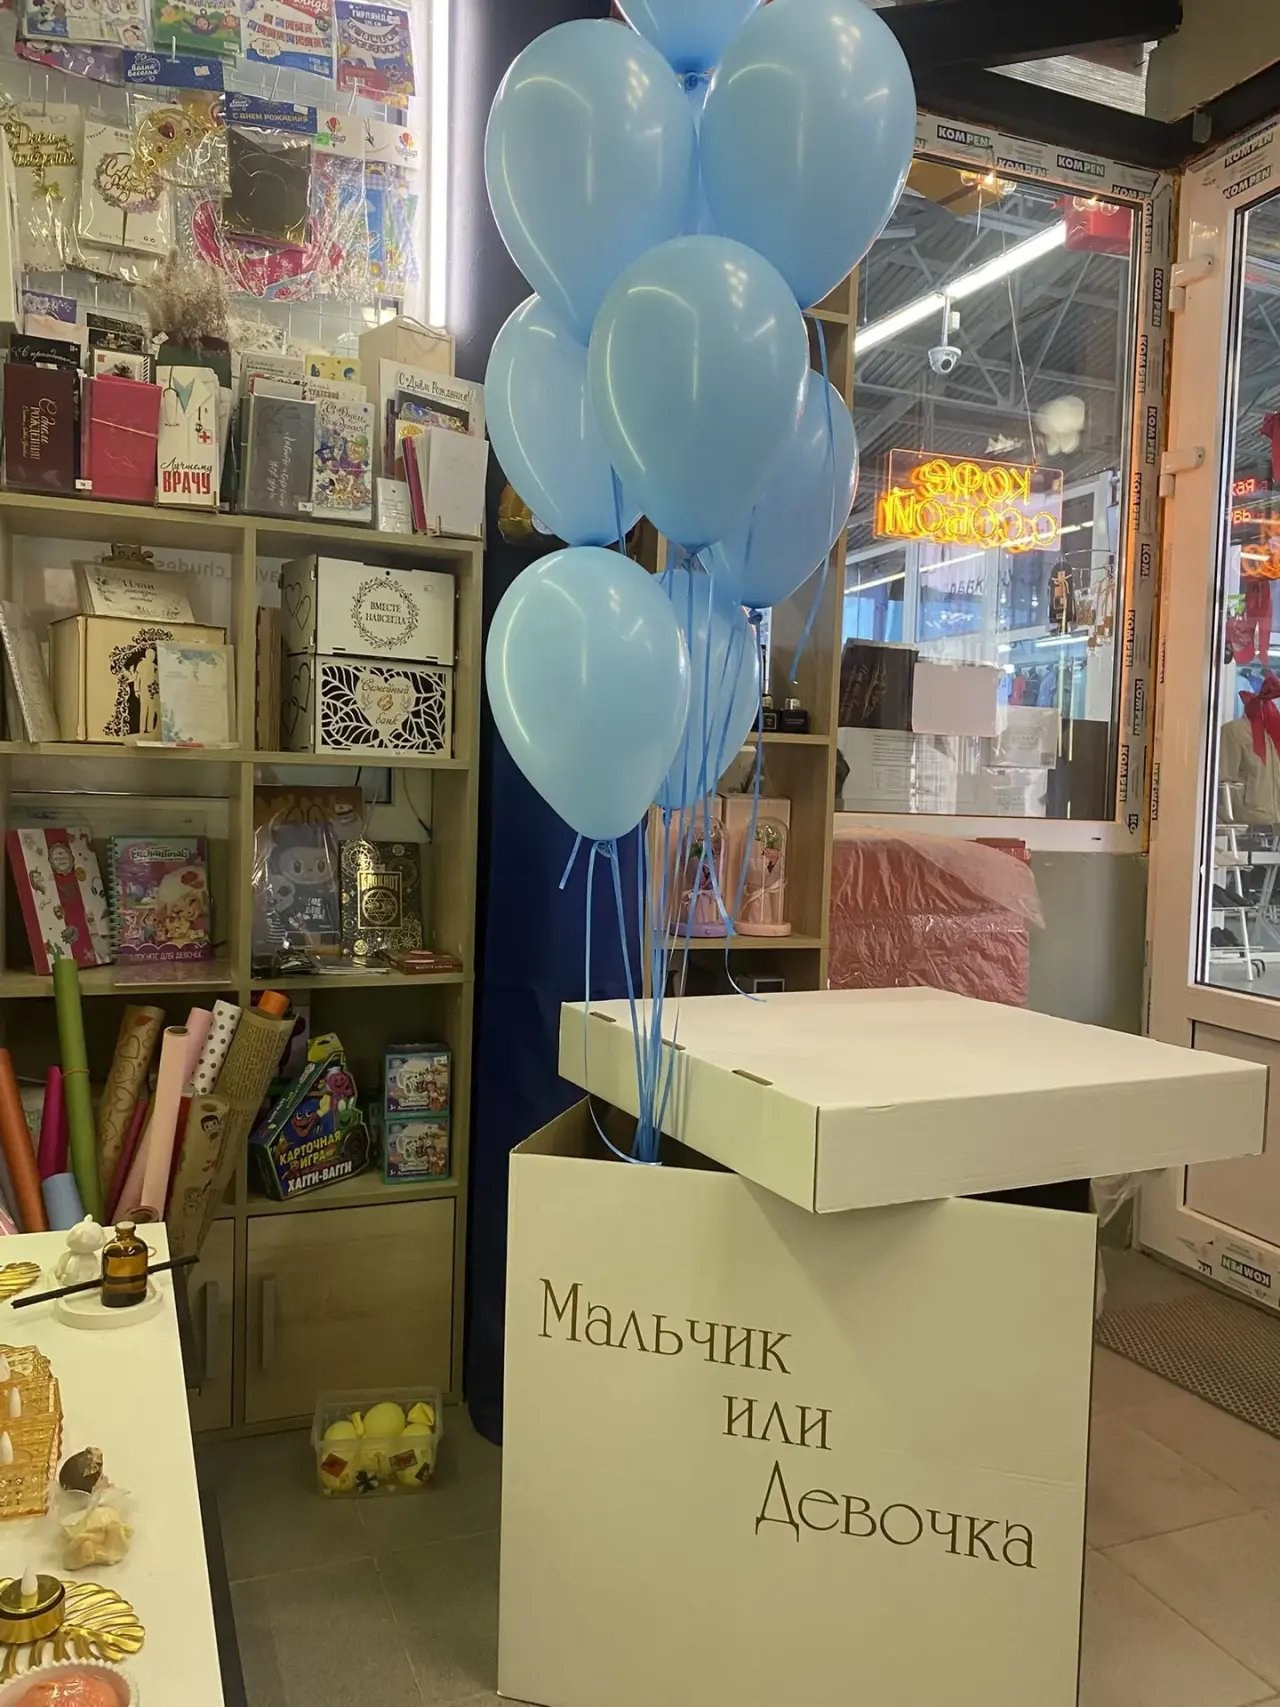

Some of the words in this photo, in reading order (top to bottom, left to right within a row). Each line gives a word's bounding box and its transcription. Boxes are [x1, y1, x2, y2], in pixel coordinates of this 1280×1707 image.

[1058, 155, 1105, 176] KOMPEN
[1223, 166, 1272, 199] KOMPEN
[1152, 269, 1163, 327] KOMPEN
[1137, 335, 1148, 393] KOMPEN
[1146, 407, 1158, 464] KOMPEN
[160, 457, 212, 473] Лучшему
[163, 471, 211, 494] ВРАЧУ
[366, 613, 406, 625] НАВСЕГДА
[371, 601, 401, 612] ВМЕСТЕ
[361, 679, 411, 694] Семейный
[376, 712, 400, 725] банк
[1133, 679, 1143, 735] KOMPEN
[1120, 745, 1129, 802] KOMPEN
[361, 874, 399, 891] БЛОКНОТ
[280, 1130, 341, 1166] КАРТОЧНАЯ
[300, 1150, 326, 1169] ИГРА
[288, 1161, 352, 1193] ХАГГИ-ВАГГИ
[1222, 1256, 1270, 1286] KOMPEN
[538, 1278, 792, 1375] Мальчик
[722, 1394, 833, 1451] или
[755, 1459, 1037, 1569] Девочка
